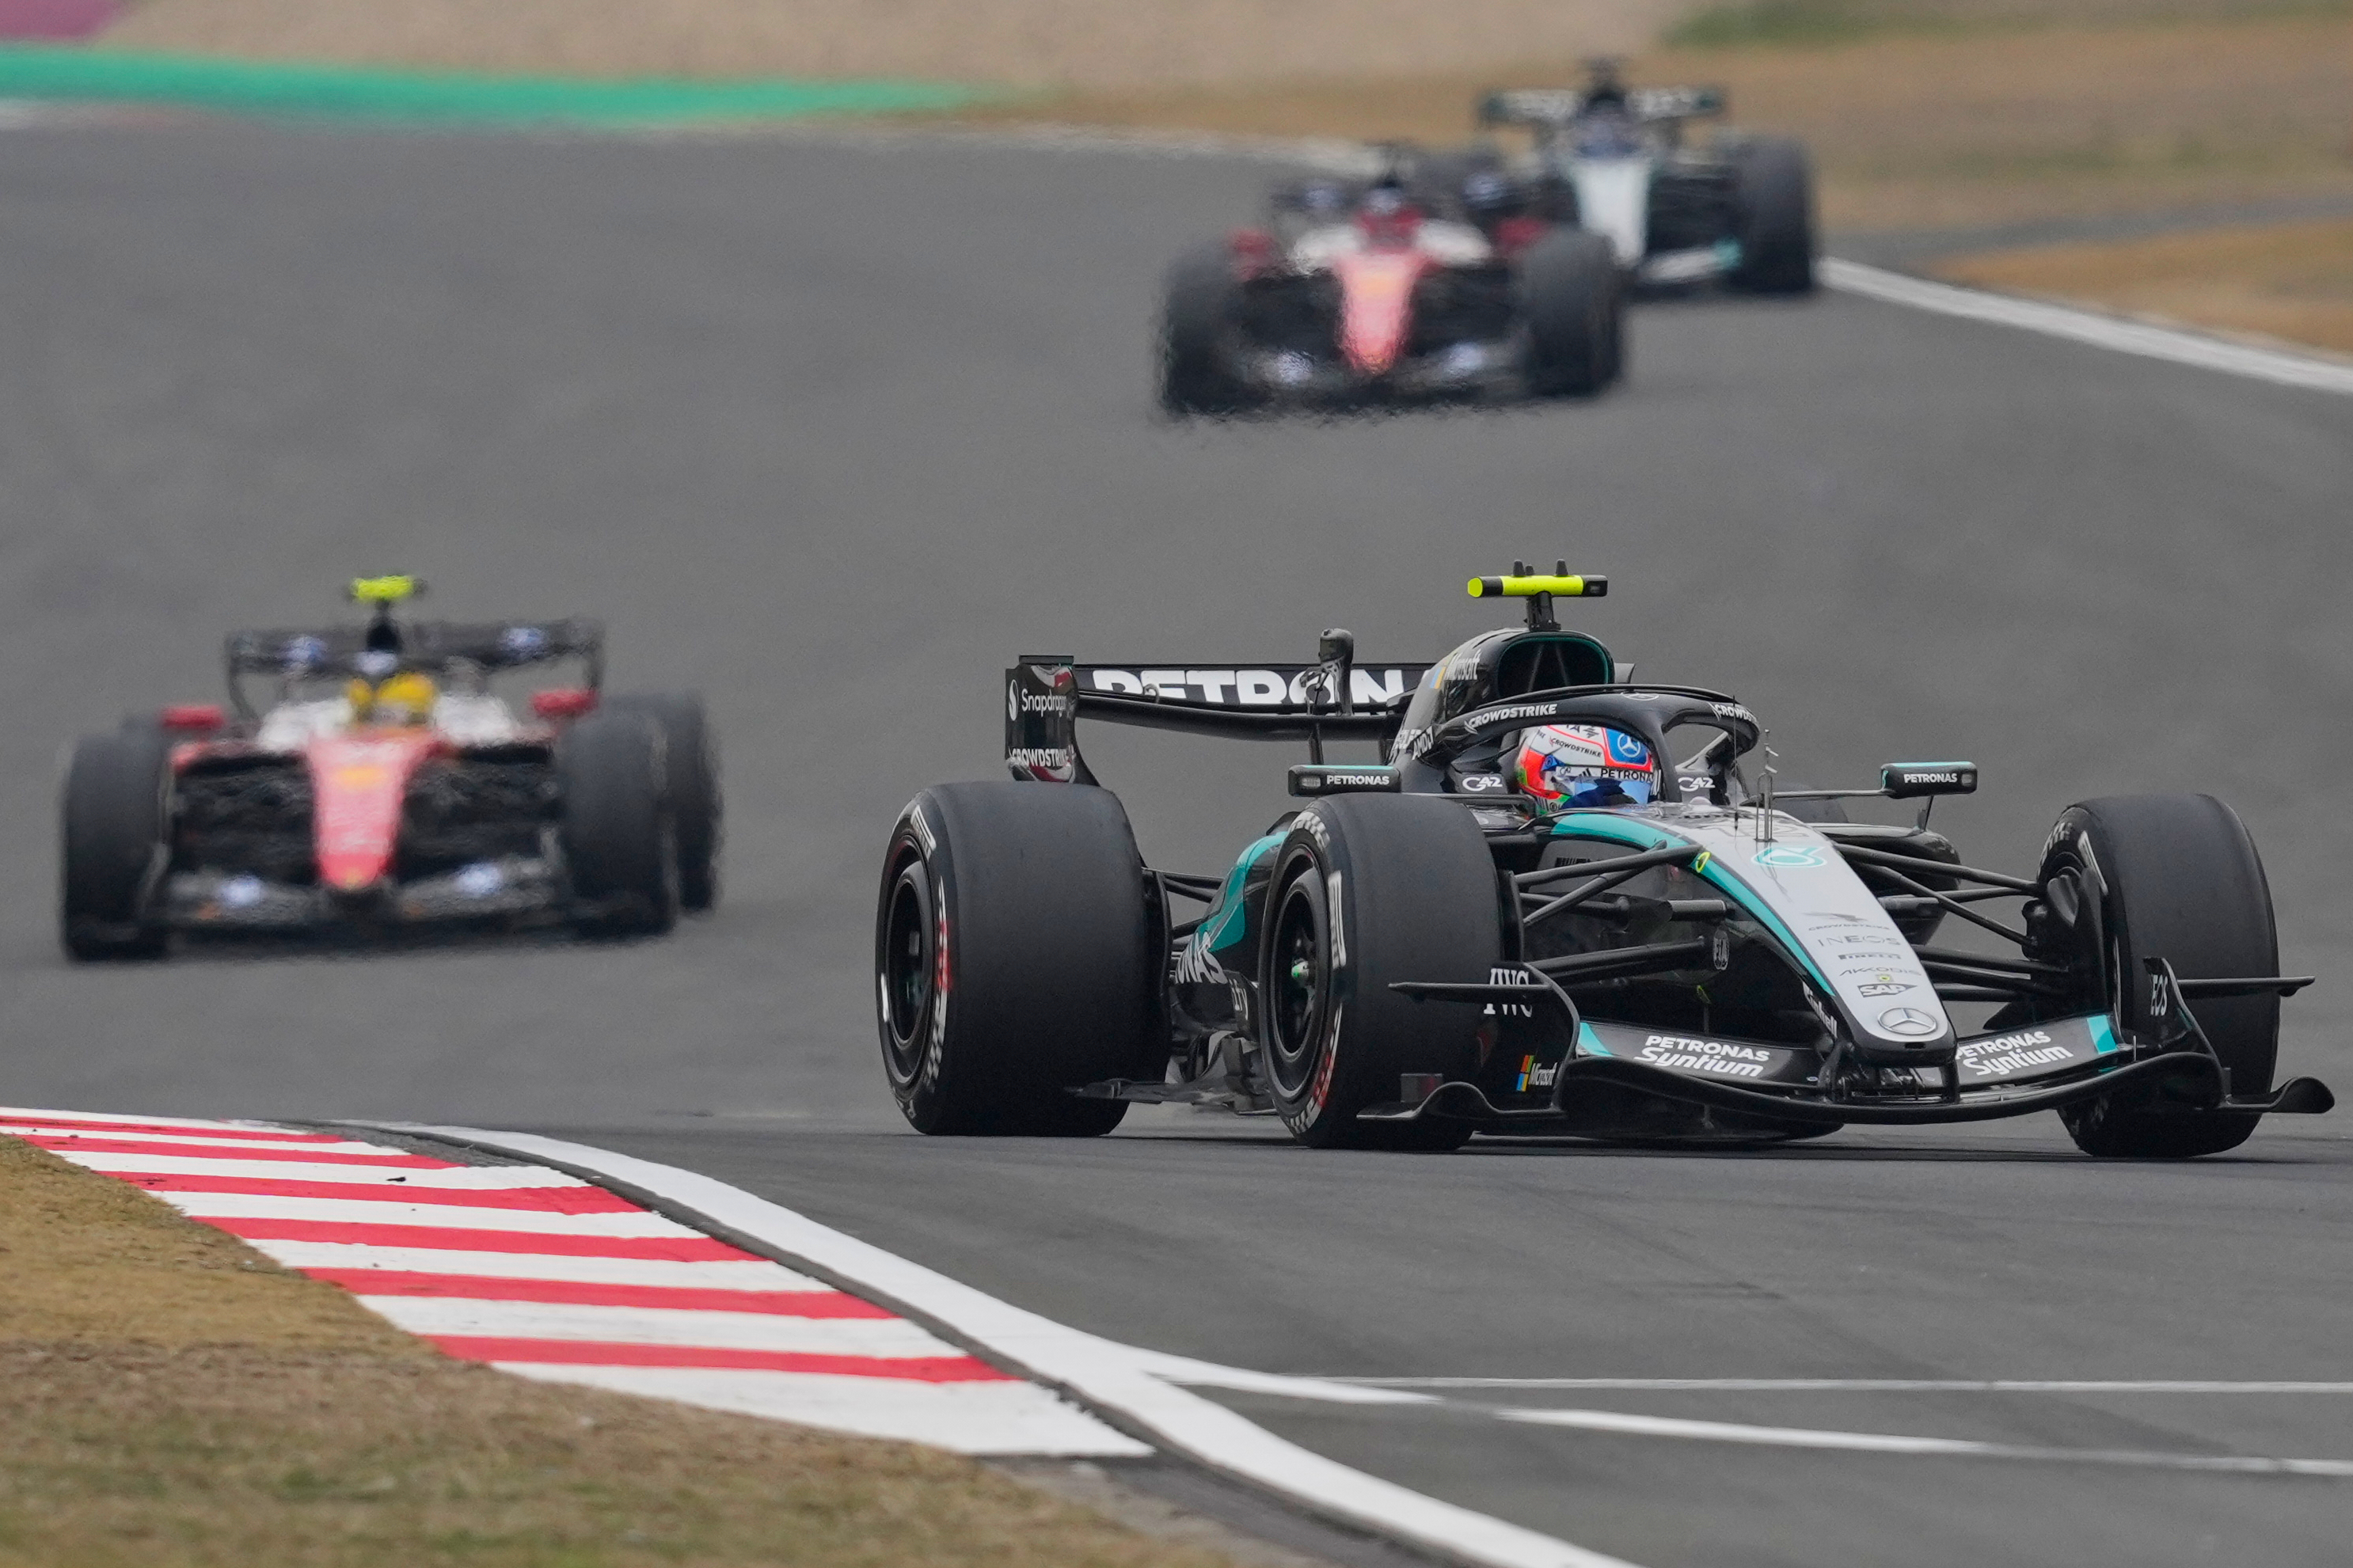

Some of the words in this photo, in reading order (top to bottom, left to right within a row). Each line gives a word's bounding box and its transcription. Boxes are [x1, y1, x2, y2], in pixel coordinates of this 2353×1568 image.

[1093, 669, 1405, 716] PETRON
[1468, 704, 1558, 729] CROWDSTRIKE
[1550, 737, 1602, 757] CROWDSTRIKE
[1325, 774, 1390, 785] PETRONAS
[1600, 768, 1655, 784] PETRONA
[1903, 773, 1958, 784] PETRONAS
[1818, 935, 1901, 947] INEOS
[1860, 984, 1907, 997] SAP
[1644, 1035, 1770, 1062] PETRONAS
[1956, 1031, 2052, 1060] PETRONAS
[1633, 1046, 1764, 1077] Syntium
[1963, 1046, 2074, 1076] Syntium
